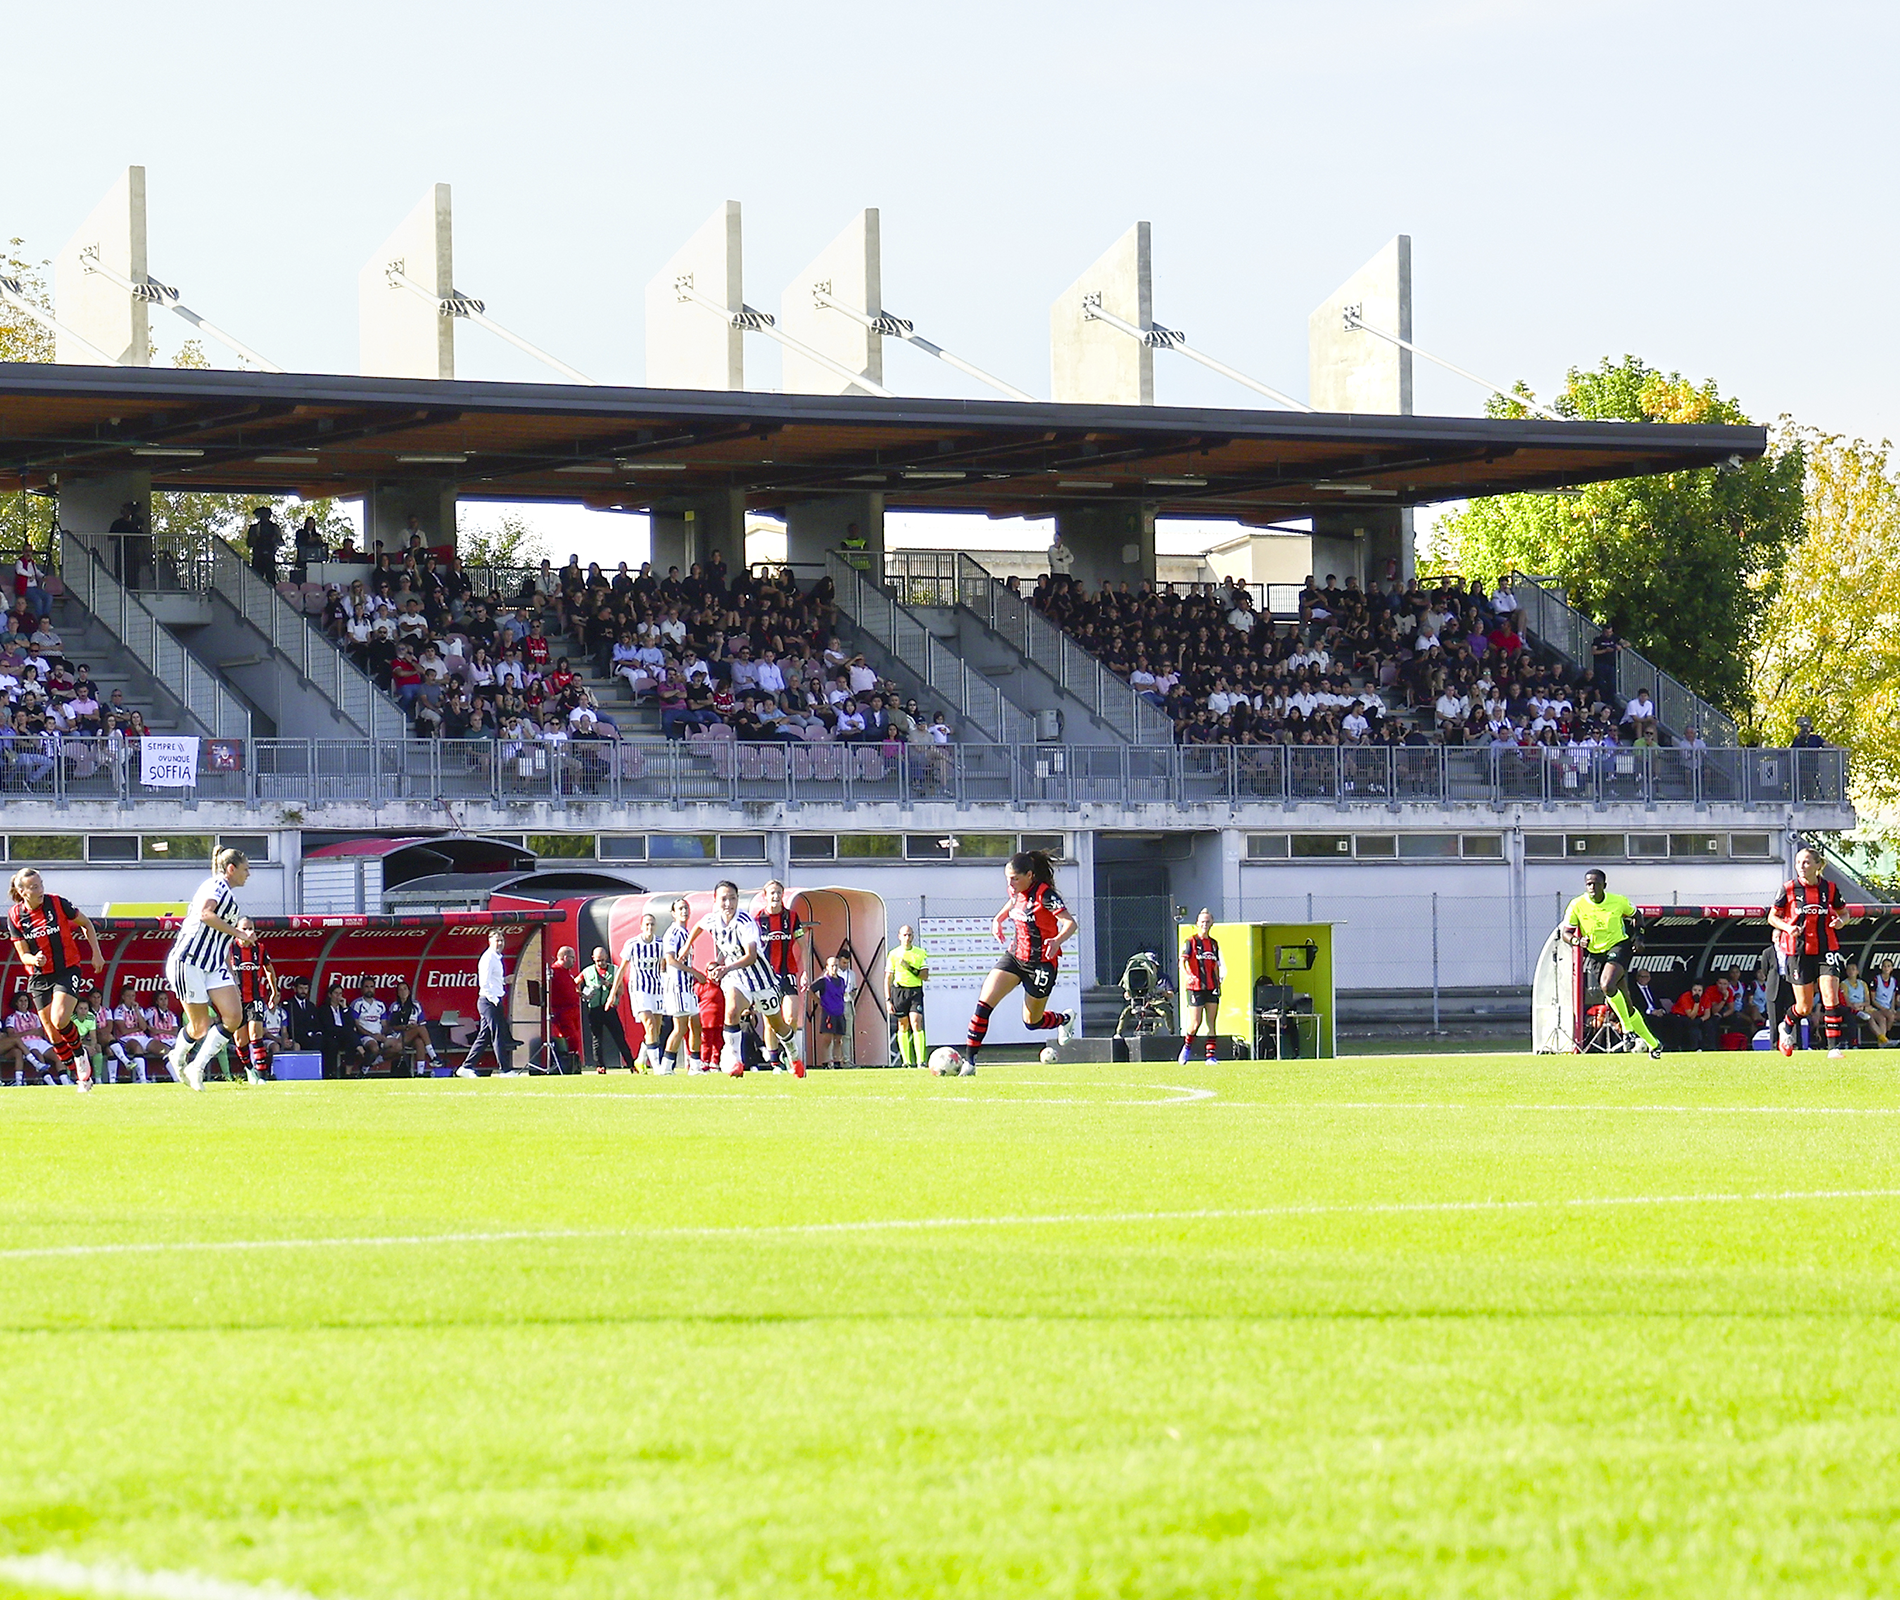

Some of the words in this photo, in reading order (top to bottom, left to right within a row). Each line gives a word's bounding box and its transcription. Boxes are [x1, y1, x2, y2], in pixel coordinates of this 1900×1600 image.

[147, 742, 176, 751] SEMPRE
[149, 765, 192, 780] SOFFIA
[1628, 955, 1675, 973] PUMA
[1711, 954, 1758, 972] PUMA
[219, 968, 230, 980] 2
[427, 970, 478, 988] Emira
[1034, 969, 1050, 986] 15
[123, 974, 173, 992] Emira
[253, 1000, 263, 1012] 18
[760, 996, 778, 1011] 30
